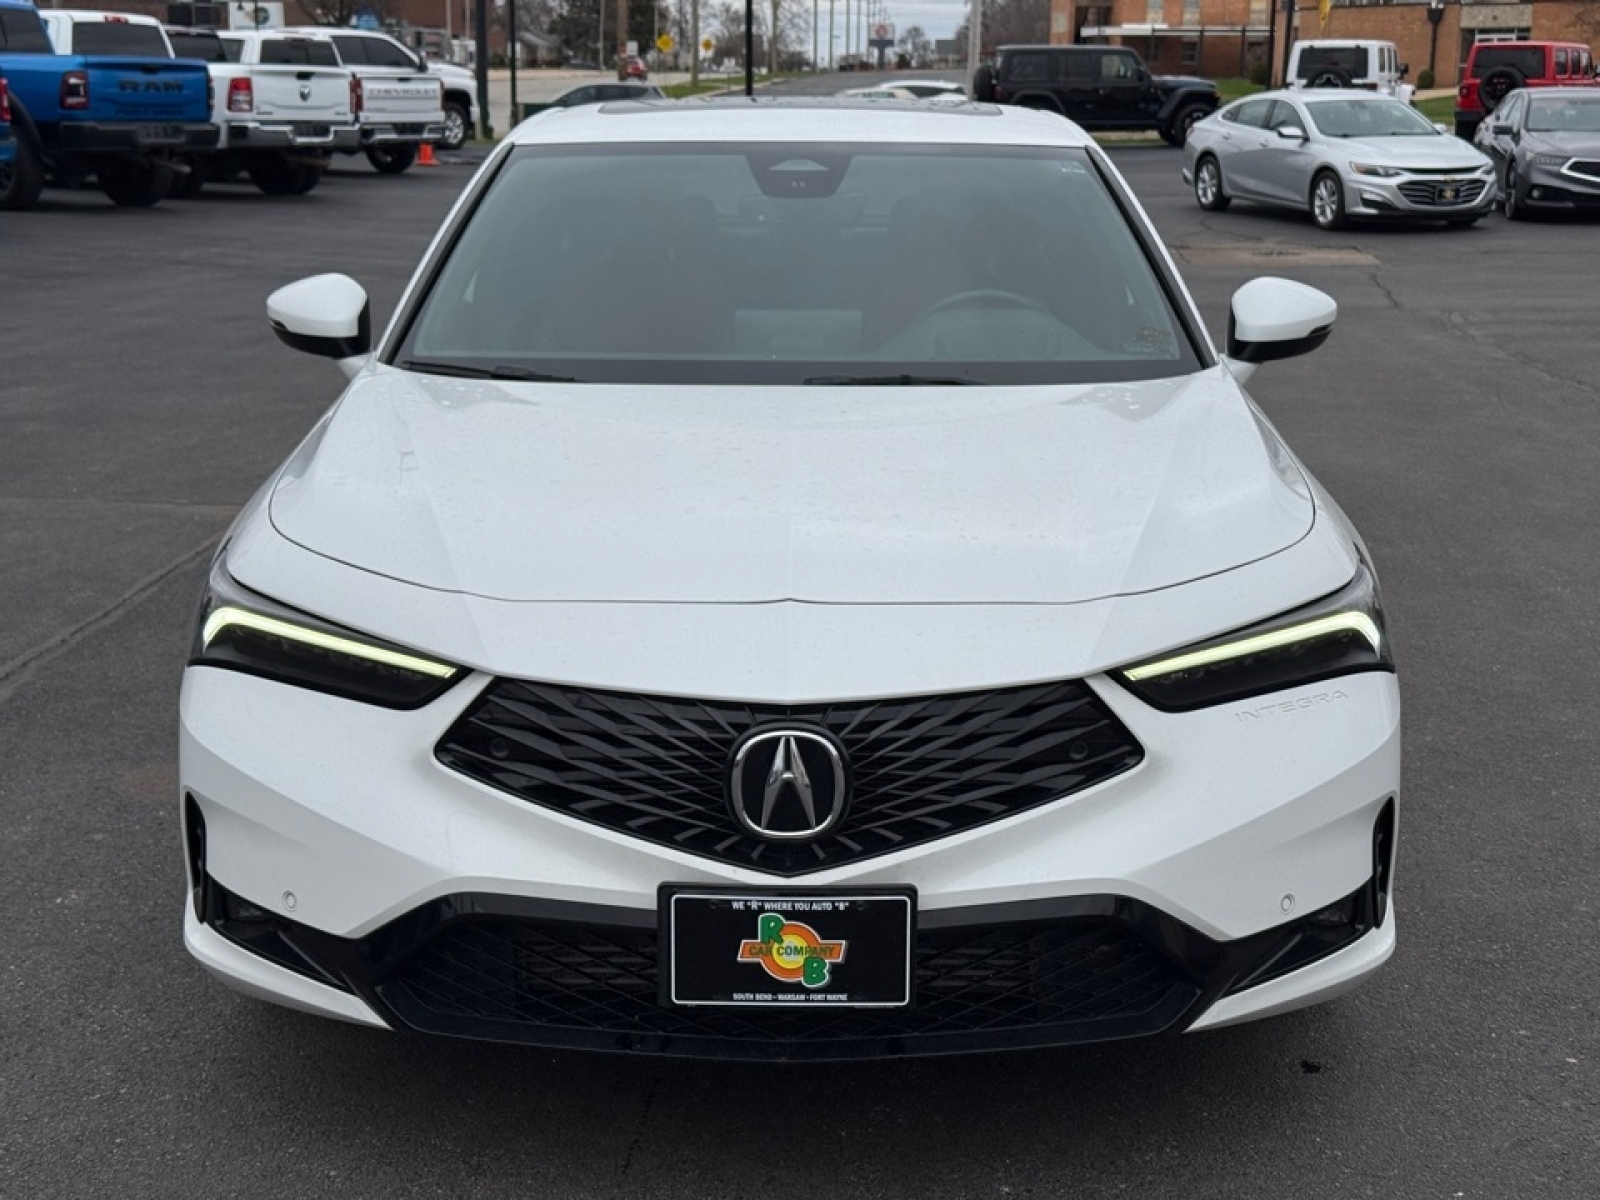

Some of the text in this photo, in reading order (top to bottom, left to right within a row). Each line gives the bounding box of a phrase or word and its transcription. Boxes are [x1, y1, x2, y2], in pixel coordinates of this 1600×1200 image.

[118, 80, 184, 93] RAM
[1234, 689, 1349, 722] INTEGRA
[732, 901, 745, 911] WE
[764, 902, 793, 911] WHERE
[794, 902, 811, 911] YOU
[811, 902, 833, 911] AUTO
[760, 914, 785, 944] R
[750, 945, 834, 956] CAR COMPANY
[803, 956, 828, 986] B
[732, 993, 754, 1001] SOUTH
